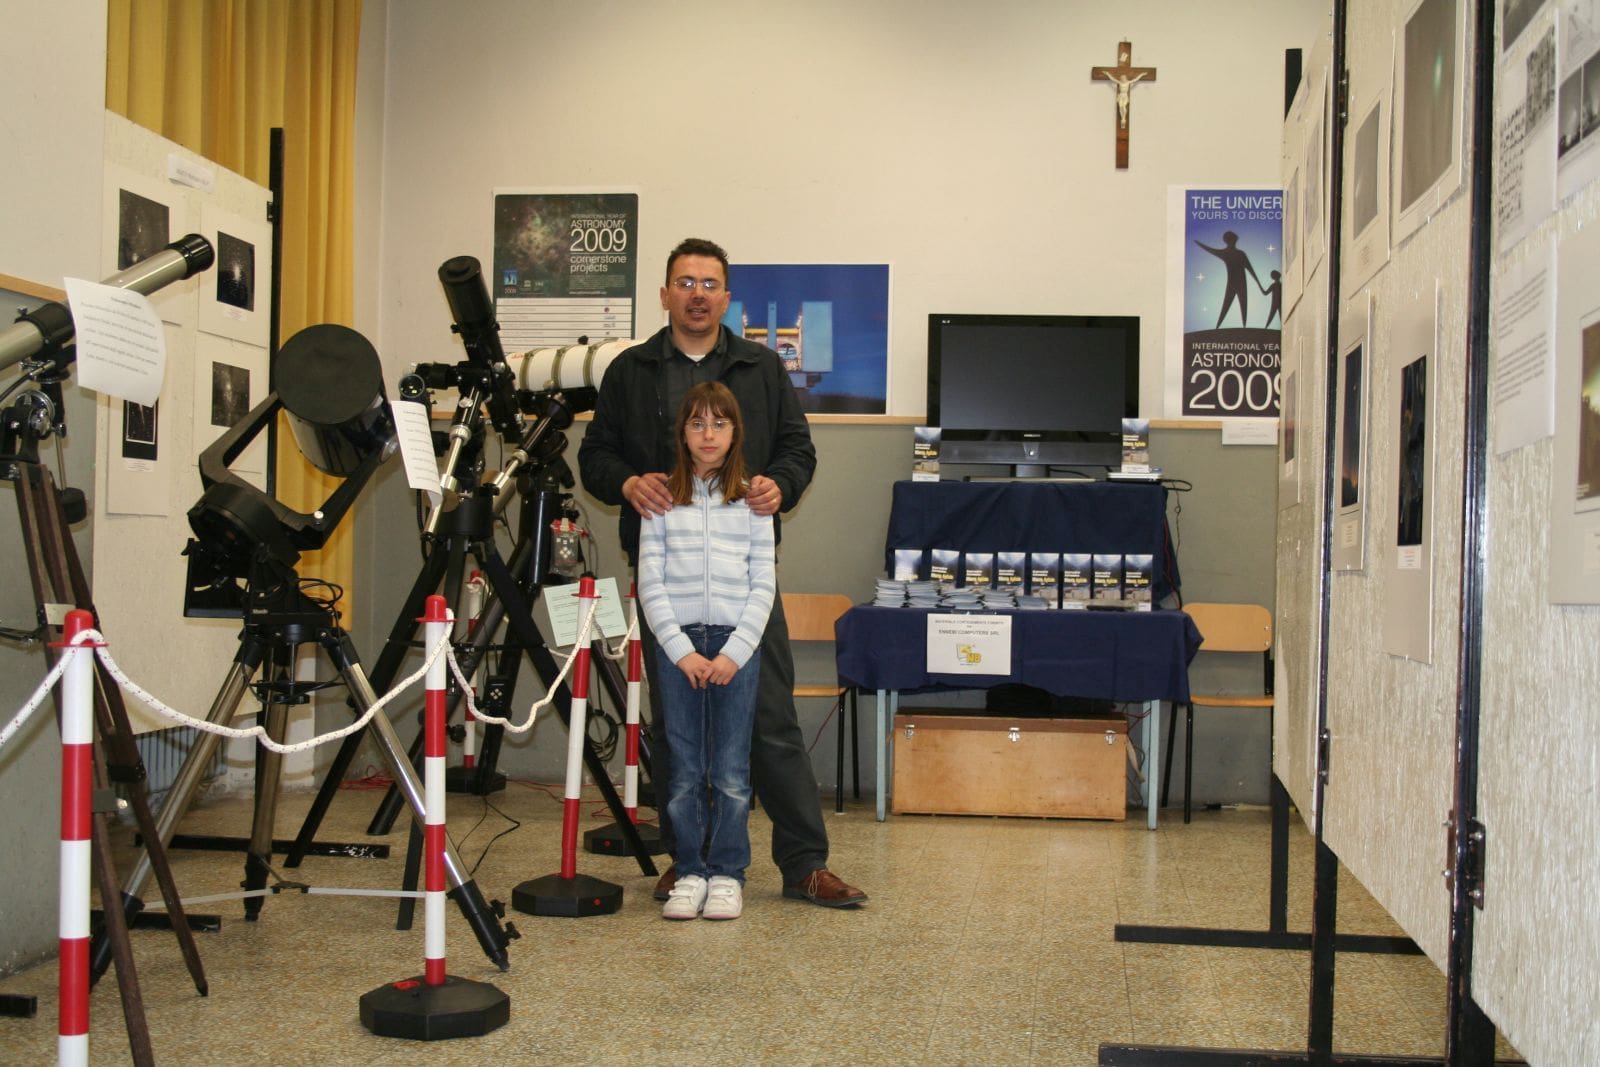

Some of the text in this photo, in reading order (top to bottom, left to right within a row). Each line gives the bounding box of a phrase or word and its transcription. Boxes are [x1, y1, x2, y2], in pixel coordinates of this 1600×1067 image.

[1192, 196, 1282, 209] THE UNIVER
[1192, 210, 1282, 220] YOURS TO DISCO
[570, 219, 626, 229] ASTRONOMY
[569, 228, 627, 252] 2009
[569, 255, 627, 264] cornerstone
[569, 263, 608, 274] projects
[1192, 342, 1261, 350] INTERNATIONAL
[1189, 369, 1281, 411] 200
